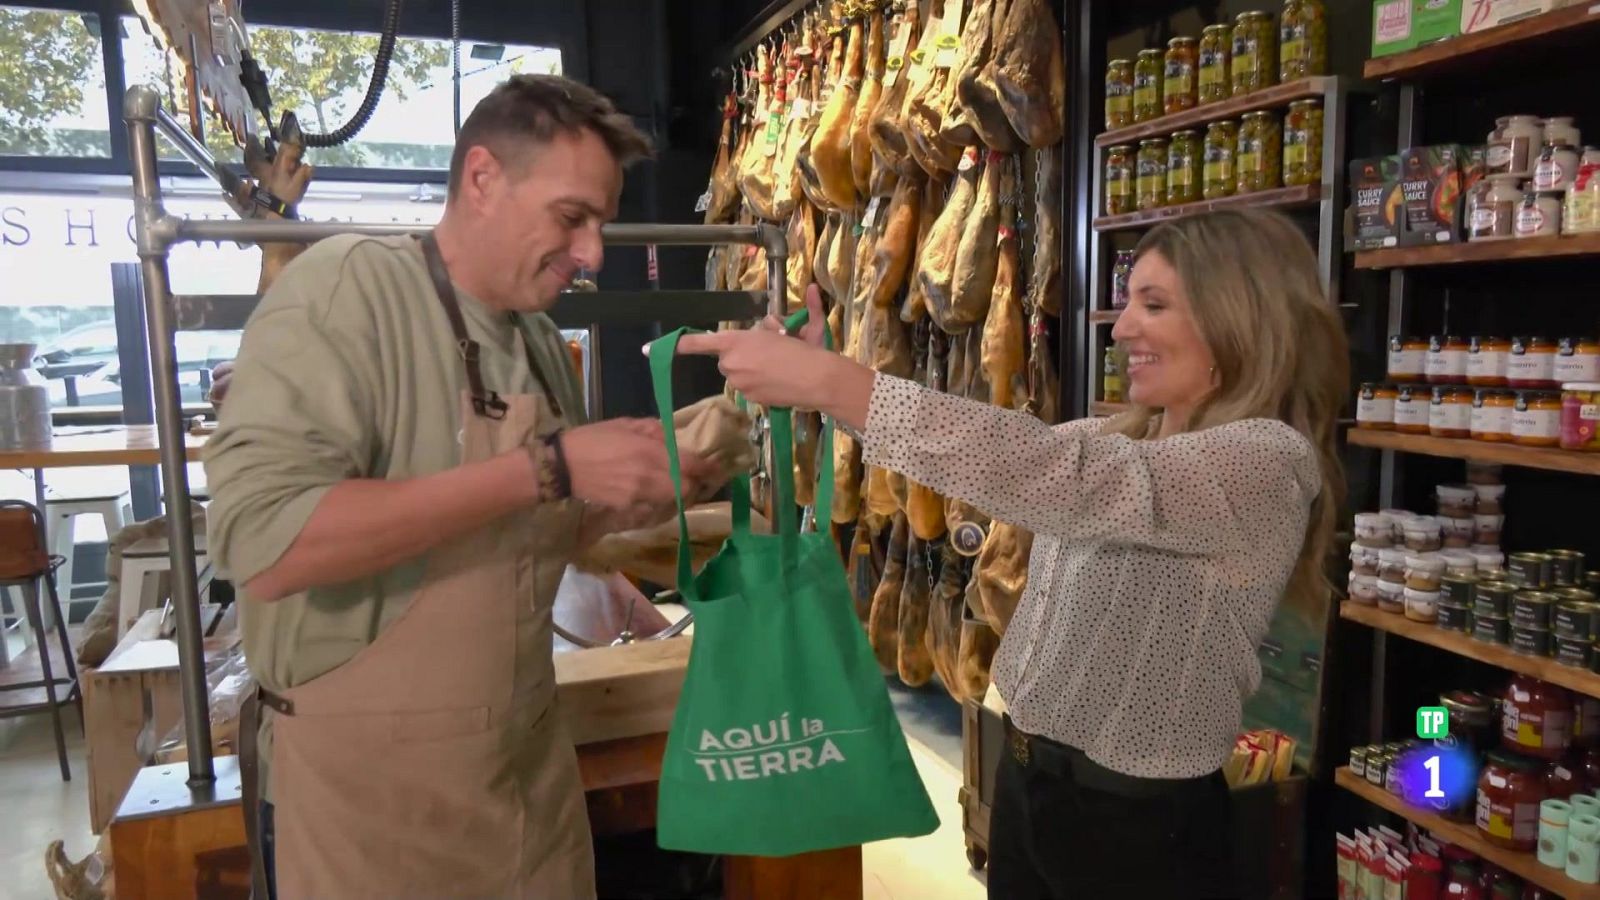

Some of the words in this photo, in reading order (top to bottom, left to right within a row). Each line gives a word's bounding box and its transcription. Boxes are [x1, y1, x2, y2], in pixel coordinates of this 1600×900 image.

[1357, 187, 1384, 198] CURRY
[1357, 198, 1381, 207] SAUCE
[699, 711, 791, 751] AQUÍ
[801, 717, 824, 737] la
[695, 738, 846, 782] TIERRA
